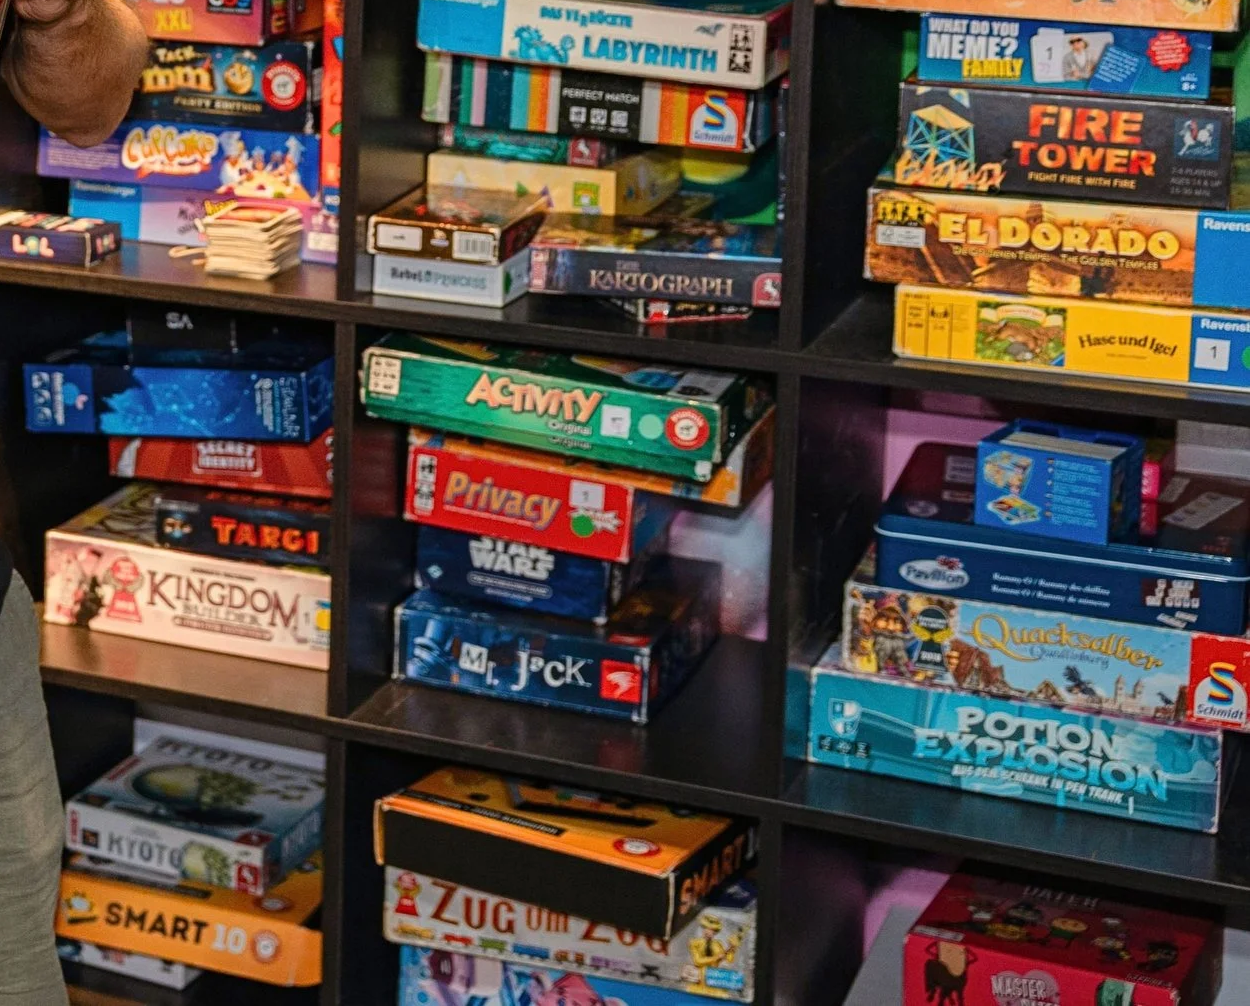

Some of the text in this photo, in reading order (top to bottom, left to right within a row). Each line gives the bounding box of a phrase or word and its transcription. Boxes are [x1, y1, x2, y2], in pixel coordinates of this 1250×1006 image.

[154, 7, 194, 31] XXL
[540, 5, 561, 20] DAS
[929, 18, 1020, 37] WHAT DO YOU
[582, 35, 718, 73] LABYRINTH
[927, 34, 1019, 60] MEME?
[962, 58, 1023, 80] FAMILY
[175, 96, 262, 113] PARTY EDITION
[562, 86, 640, 105] PERFECT MATCH
[694, 130, 736, 144] Schmidt
[1029, 104, 1144, 144] FIRE
[1012, 140, 1157, 177] TOWER
[1028, 171, 1137, 190] FIGHT FIRE WITH FIRE
[938, 212, 1181, 260] EL DORADO
[589, 267, 734, 298] KARTOGRAPH
[1079, 334, 1178, 358] Hase und Igel
[466, 372, 602, 423] ACTIVITY
[550, 419, 592, 436] Original
[444, 471, 560, 532] Privacy
[210, 515, 320, 555] TARGI
[469, 549, 554, 581] WARS
[906, 563, 966, 588] Pavilion
[146, 569, 301, 629] KINGDOM
[970, 613, 1164, 672] Quacksalber
[1197, 703, 1244, 722] Schmidt
[955, 706, 1122, 761] POTION
[912, 729, 1168, 803] EXPLOSION
[107, 832, 182, 870] KYOTO
[104, 901, 248, 956] SMART 10
[992, 974, 1047, 1001] MASTER
